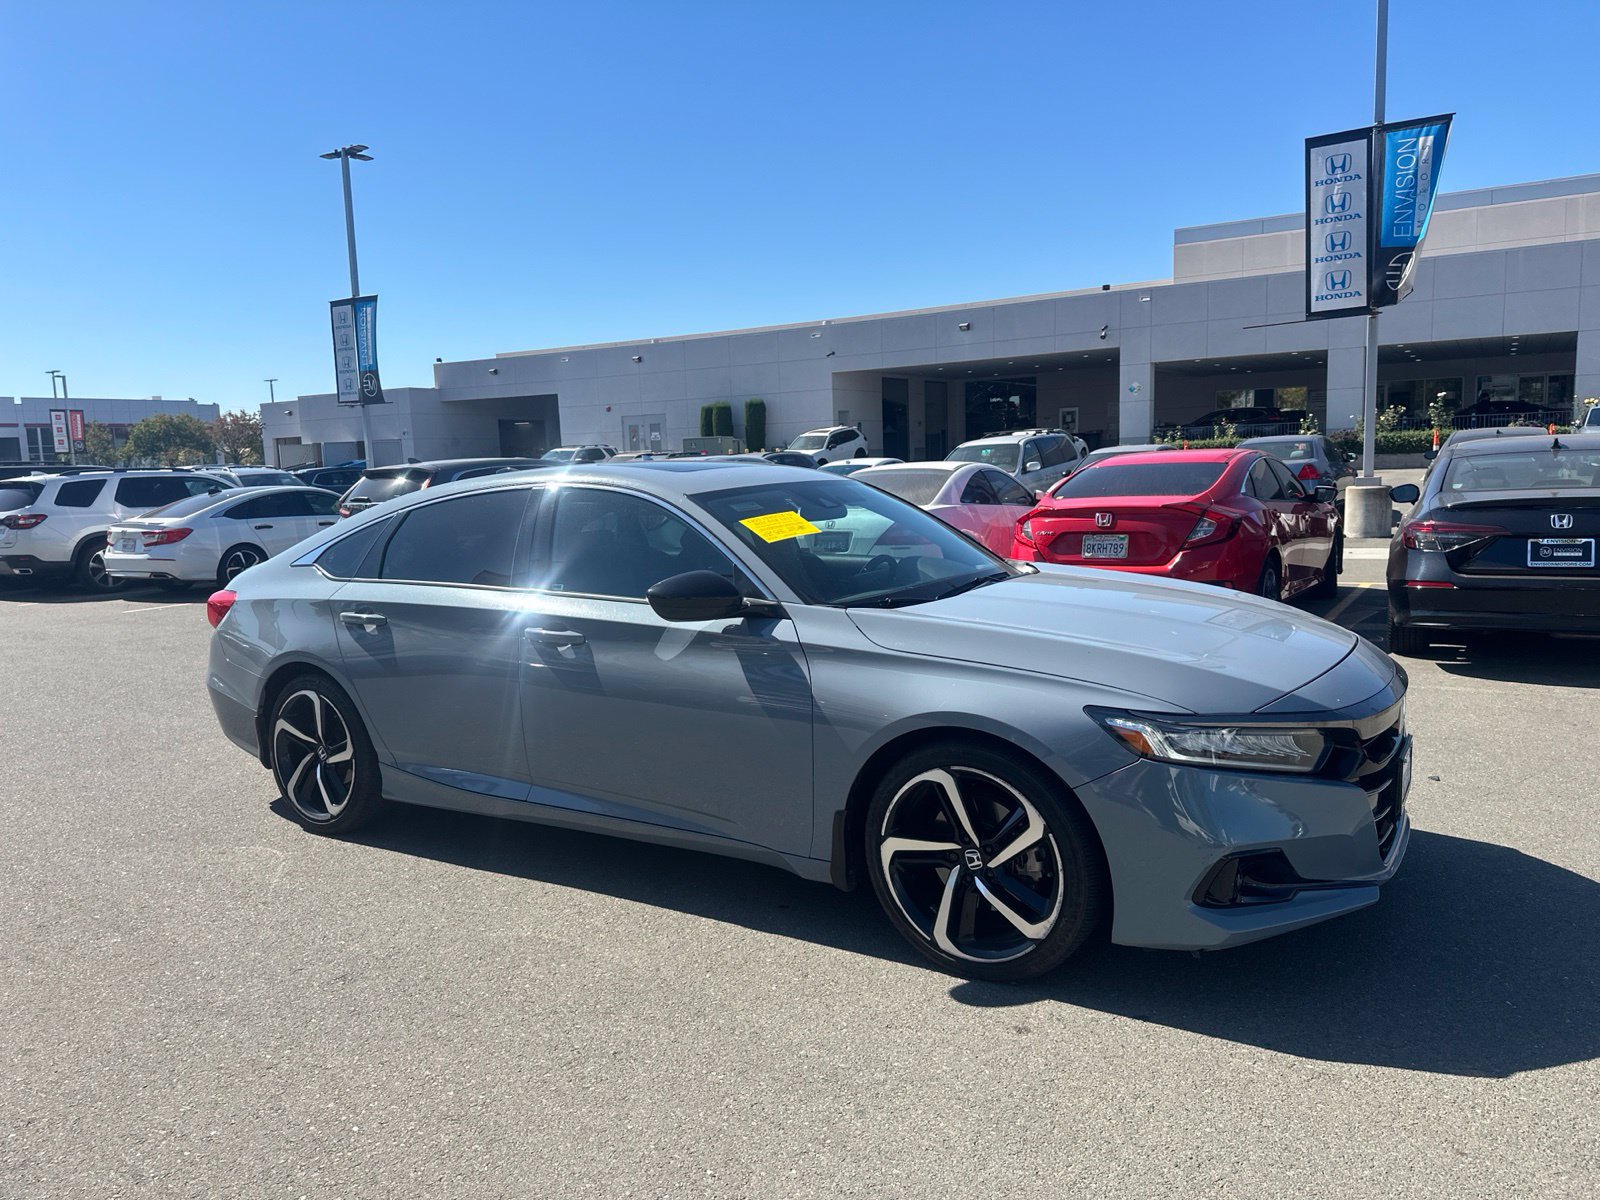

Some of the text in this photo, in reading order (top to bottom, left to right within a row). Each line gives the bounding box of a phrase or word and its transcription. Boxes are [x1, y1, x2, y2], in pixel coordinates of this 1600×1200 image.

[1314, 174, 1362, 187] HONDA
[1417, 144, 1430, 229] MOTORS
[1393, 137, 1416, 238] ENVISION
[1314, 213, 1362, 225] HONDA
[1314, 252, 1362, 264] HONDA
[1314, 291, 1362, 301] HONDA
[1086, 543, 1124, 554] 8KRH789
